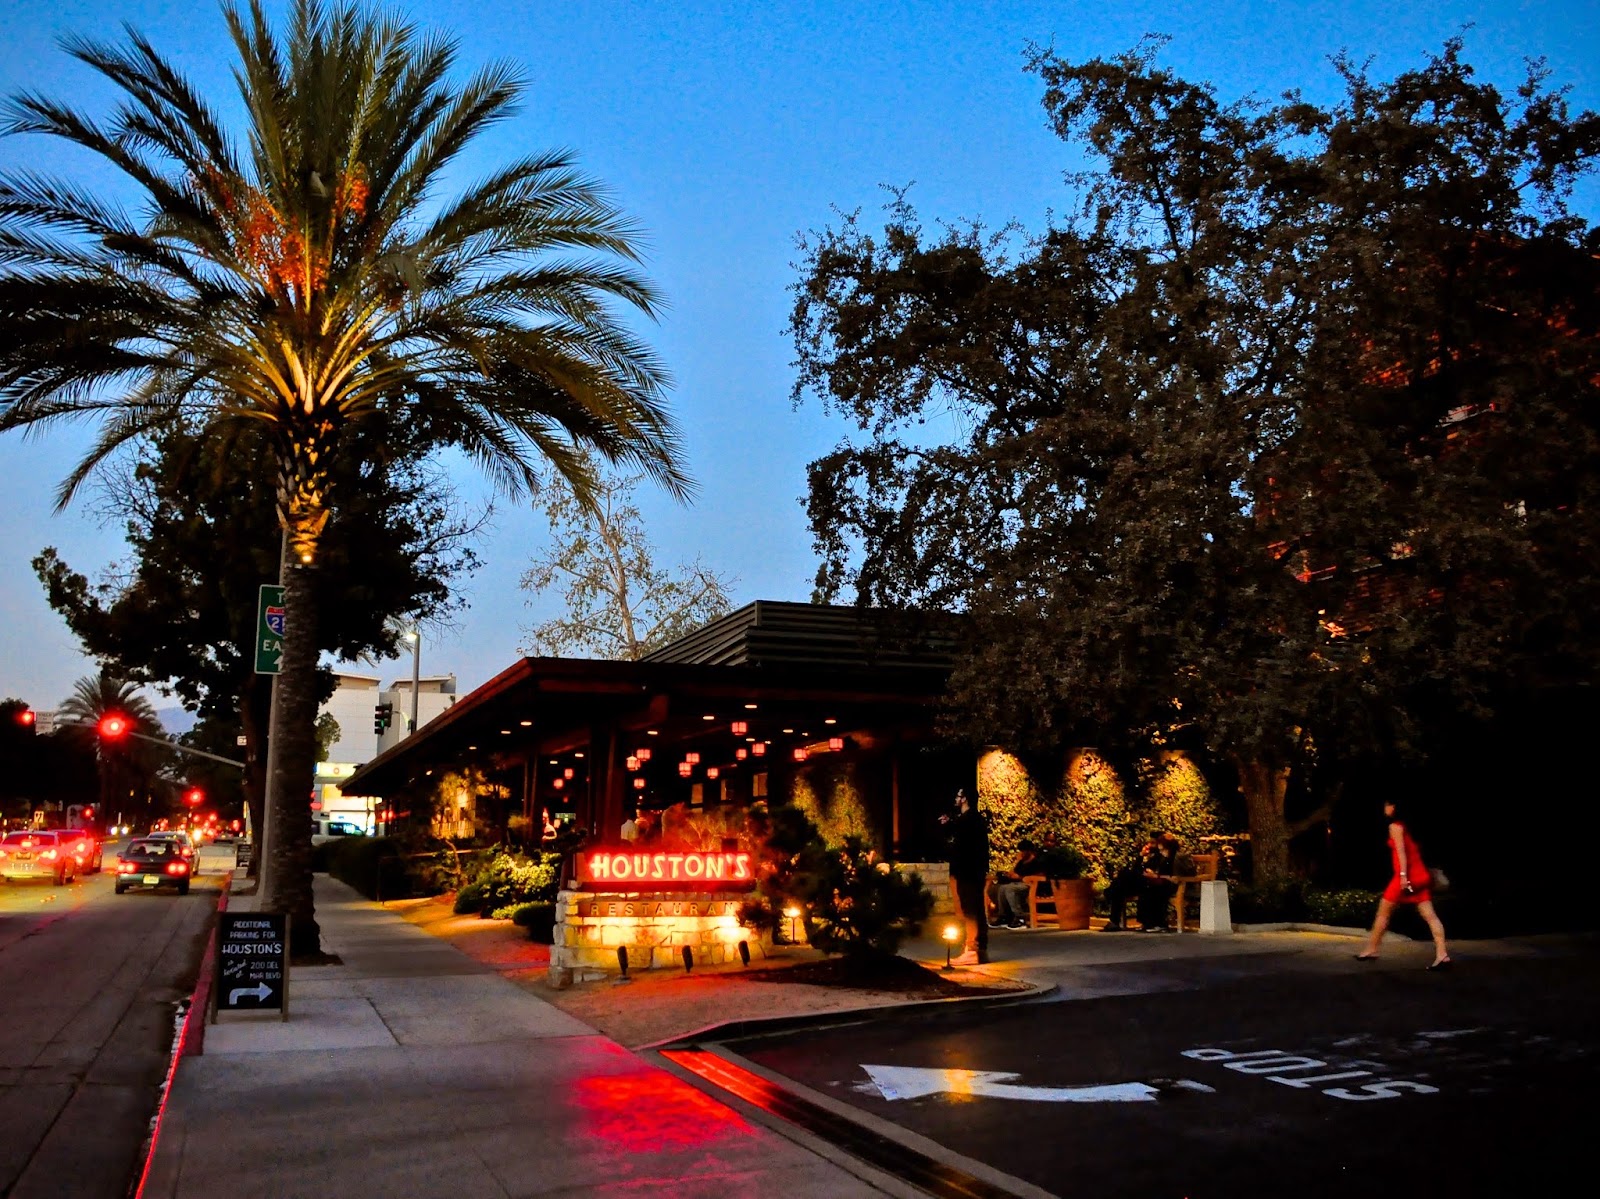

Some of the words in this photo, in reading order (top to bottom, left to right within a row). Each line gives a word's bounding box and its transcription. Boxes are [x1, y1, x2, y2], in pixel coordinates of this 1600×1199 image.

[263, 640, 282, 652] EA
[590, 852, 749, 879] HOUSTON'S
[590, 902, 735, 916] RESTAURAN
[233, 920, 271, 929] ADDITIONAL
[229, 931, 260, 939] PARKING
[262, 931, 276, 939] FOR
[222, 942, 282, 954] HOUSTON'S
[250, 961, 265, 969] 200
[266, 961, 279, 969] DEL
[250, 971, 264, 979] MAR
[266, 971, 281, 979] BLVD
[1180, 1048, 1440, 1101] STOP
